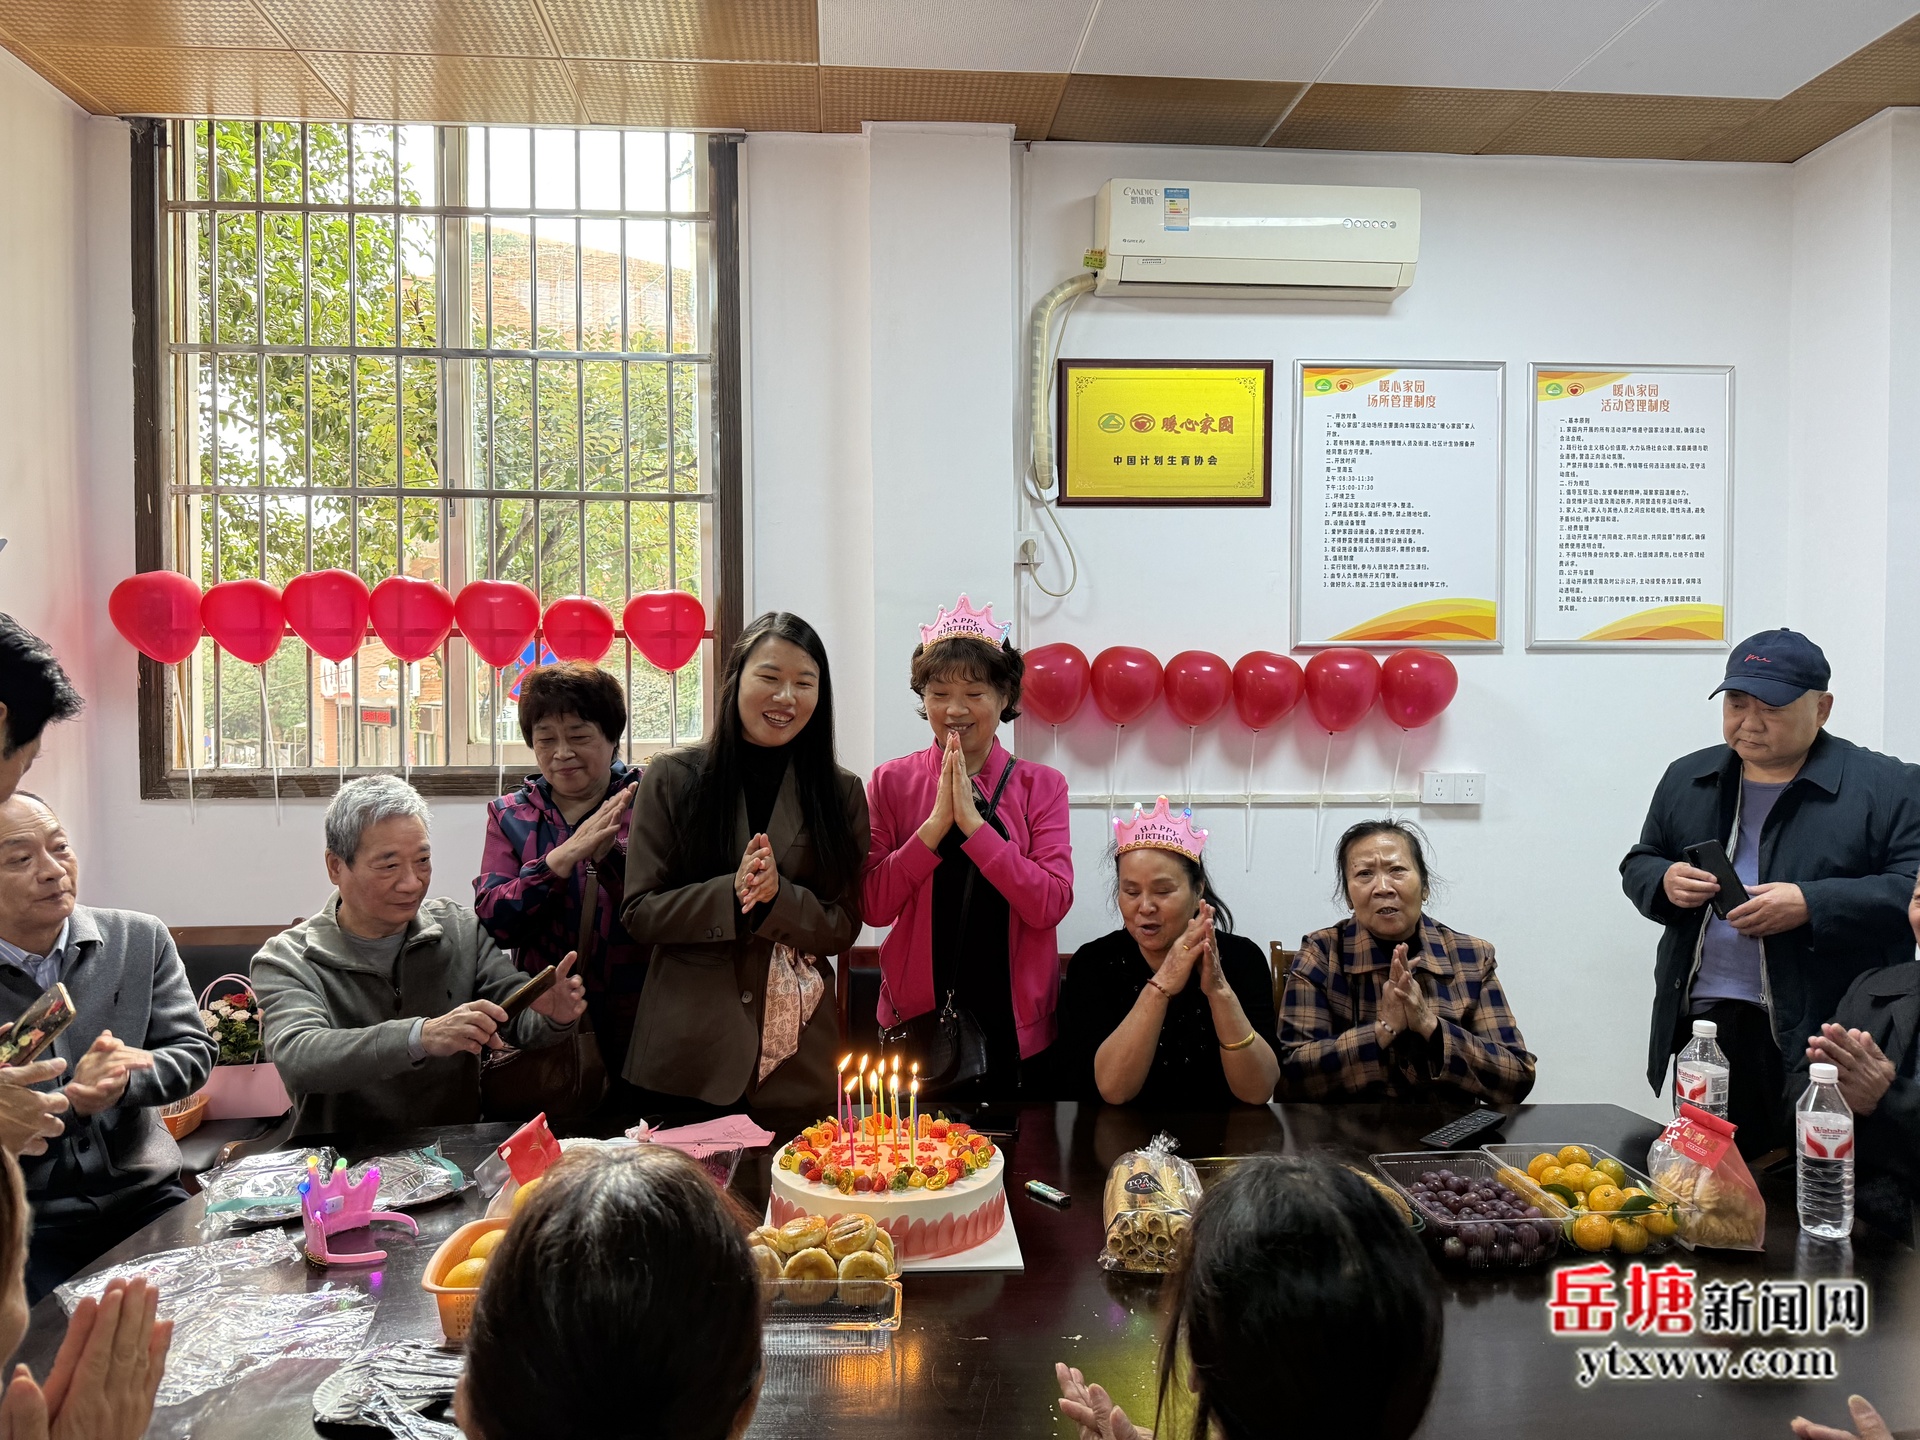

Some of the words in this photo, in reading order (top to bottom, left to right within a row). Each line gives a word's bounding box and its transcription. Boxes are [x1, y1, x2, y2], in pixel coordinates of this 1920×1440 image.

[1378, 379, 1425, 393] 暖心家园
[1612, 383, 1659, 397] 暖心家园
[1367, 394, 1437, 408] 场所管理制度
[1601, 398, 1671, 412] 活动管理制度
[1161, 412, 1235, 435] 暖心家园
[1113, 455, 1218, 466] 中国计划生育协会
[1325, 457, 1357, 465] 二、开放时间
[1325, 466, 1353, 474] 周一至周五
[942, 617, 980, 628] HAPPY
[937, 625, 985, 635] BIRTHDAY
[1139, 823, 1179, 836] HAPPY
[1134, 833, 1184, 845] BIRTHDAY
